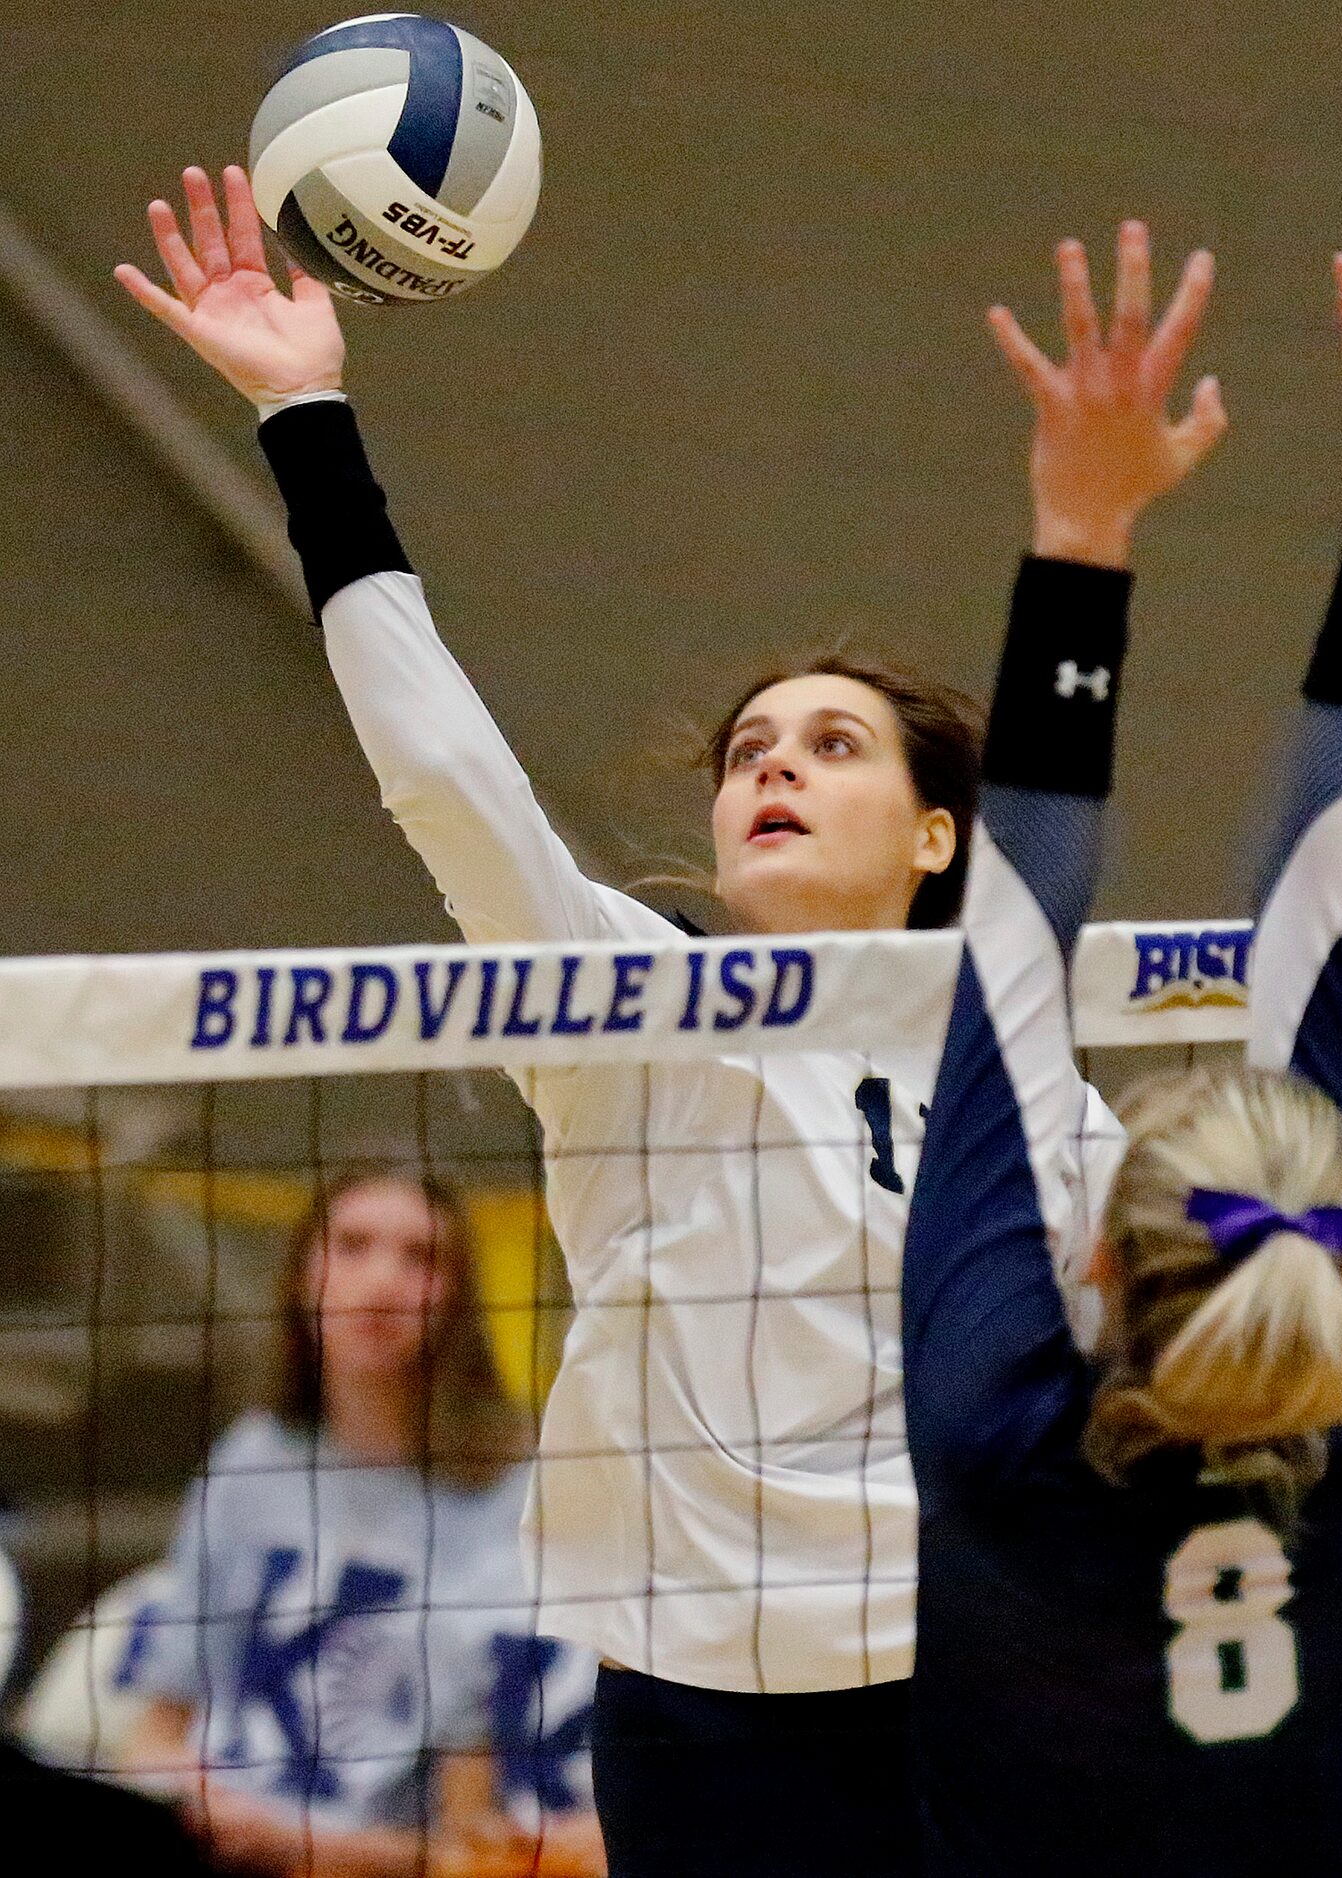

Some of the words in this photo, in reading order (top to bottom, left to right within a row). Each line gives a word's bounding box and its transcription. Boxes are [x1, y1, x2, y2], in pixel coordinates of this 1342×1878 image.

[382, 201, 475, 260] TF-VB5
[191, 954, 654, 1049] BIRDVILLE
[678, 948, 817, 1029] ISD
[1164, 1518, 1300, 1744] 8
